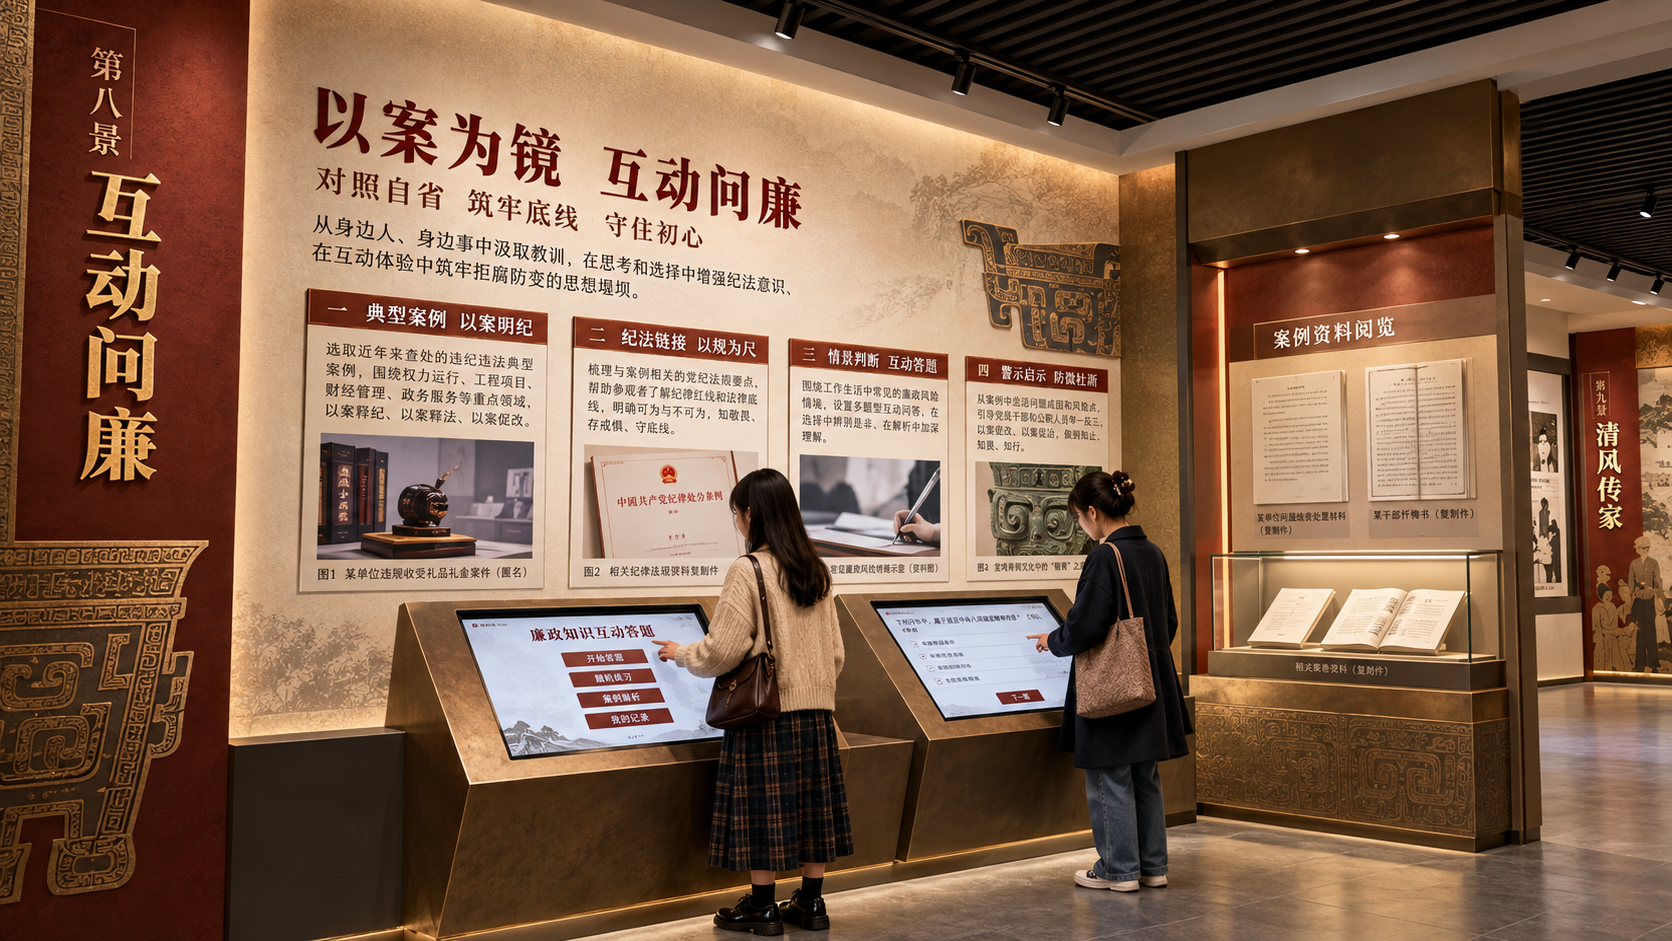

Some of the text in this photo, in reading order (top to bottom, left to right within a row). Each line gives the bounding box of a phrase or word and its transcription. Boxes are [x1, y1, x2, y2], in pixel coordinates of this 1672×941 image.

[89, 46, 124, 157] 第八景
[313, 86, 802, 230] 以案为镜 互动问廉
[315, 166, 704, 249] 对照自省 筑牢底线 守住初心
[80, 170, 162, 482] 互动问廉
[366, 302, 447, 329] 典型案例
[460, 312, 533, 337] 以案明纪
[1273, 316, 1395, 350] 案例资料阅览
[326, 342, 534, 371] 选取近年来查处的违纪违法典型
[589, 328, 757, 358] 二 纪法链接 以规为尺
[802, 347, 938, 374] 三 情景判断 互动答题
[978, 363, 1098, 388] 四 警示启示 防微杜渐
[1596, 421, 1623, 530] 清风传家
[317, 568, 336, 581] 图1
[584, 566, 600, 577] 图2
[530, 624, 656, 642] 廉政知识互动答题
